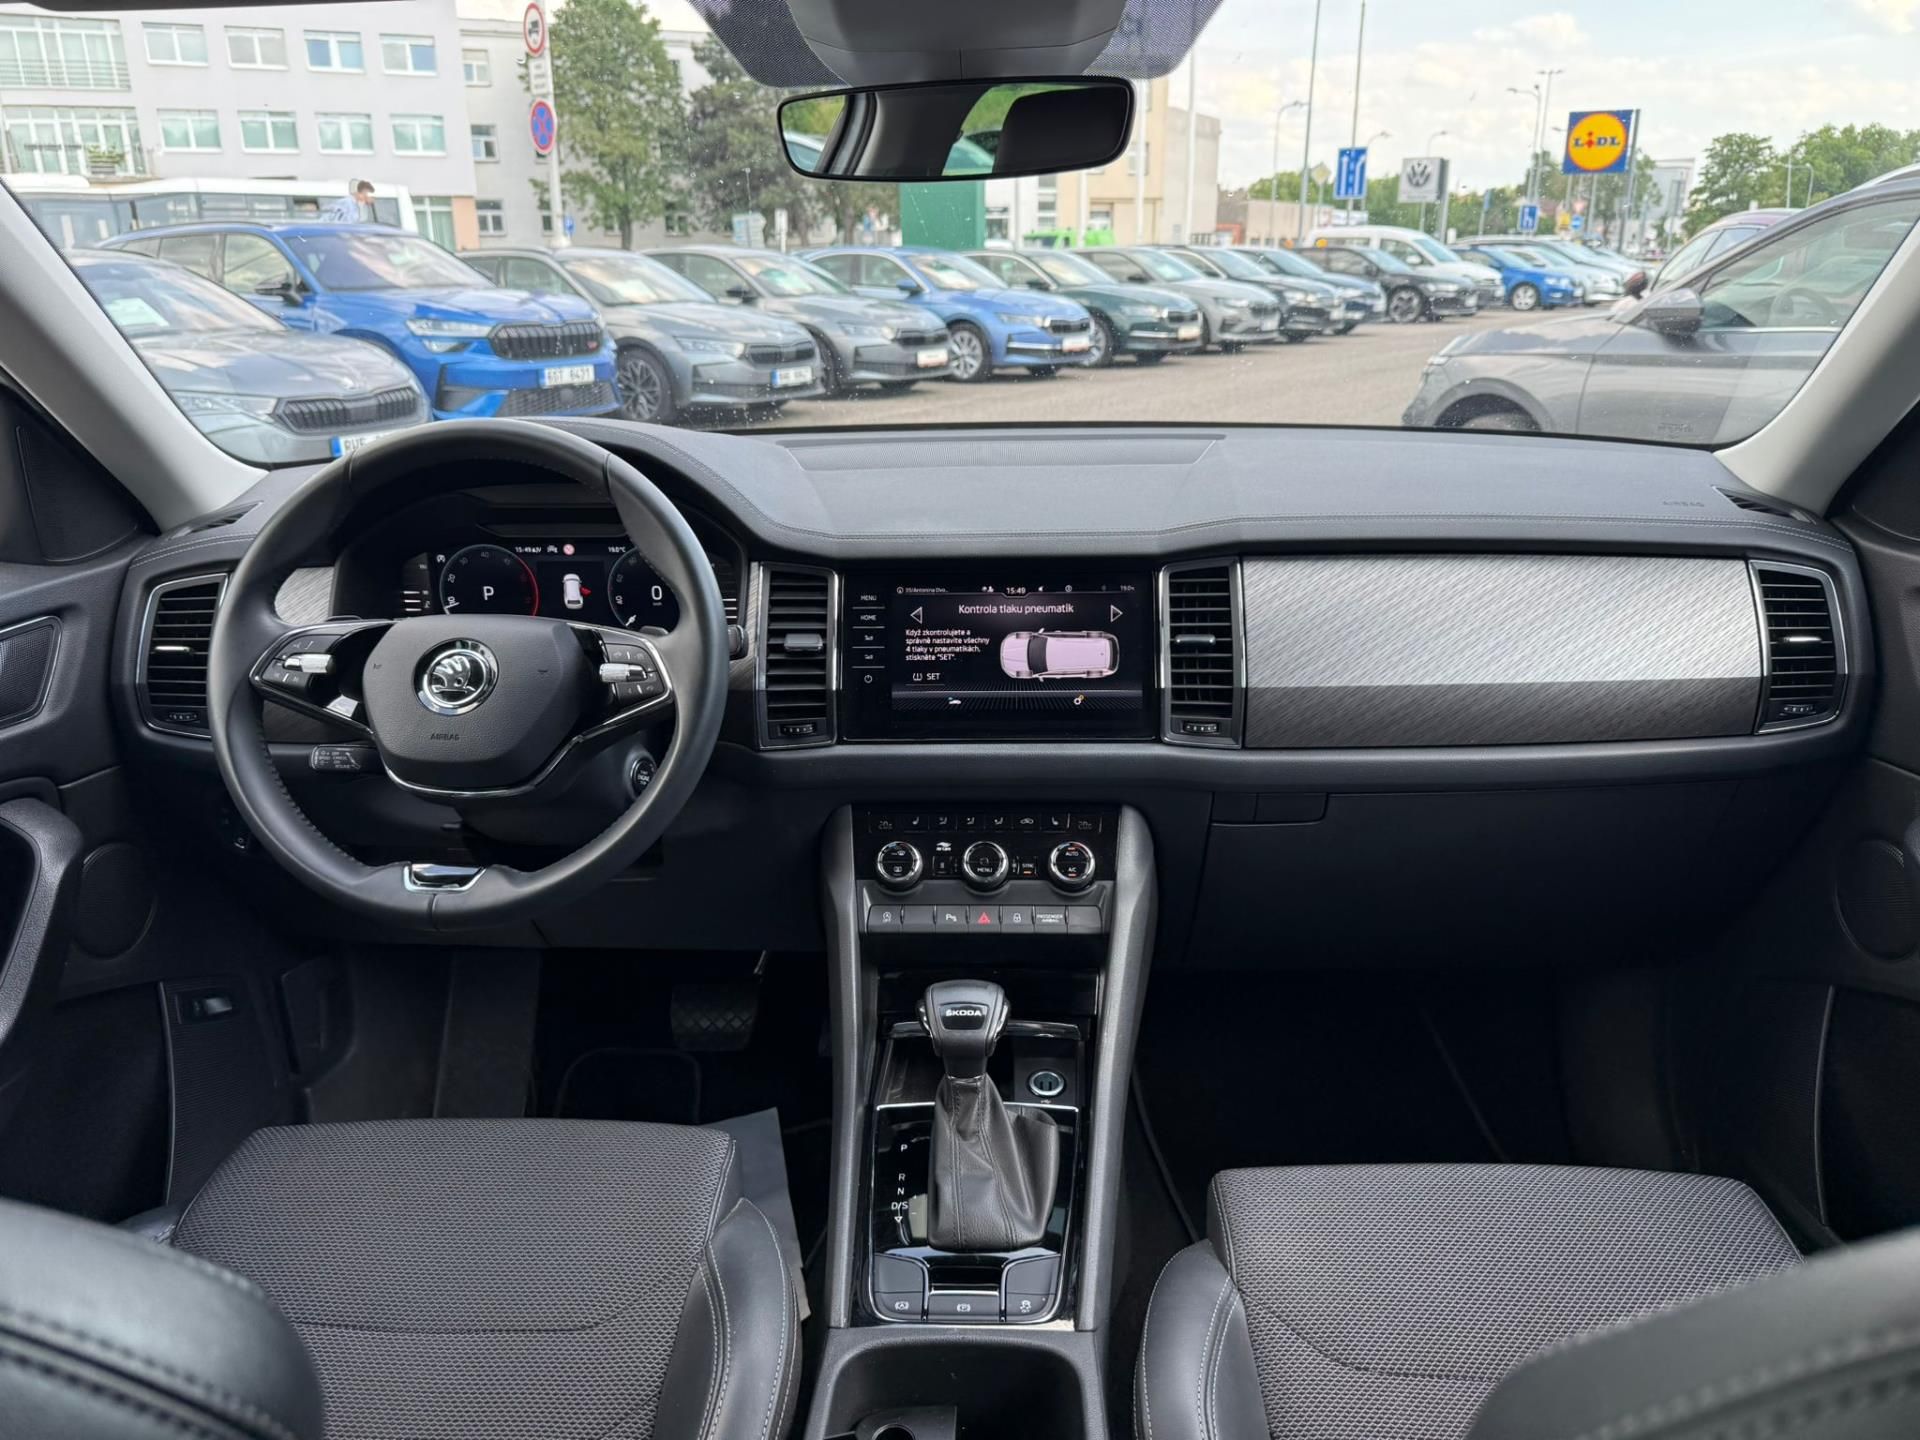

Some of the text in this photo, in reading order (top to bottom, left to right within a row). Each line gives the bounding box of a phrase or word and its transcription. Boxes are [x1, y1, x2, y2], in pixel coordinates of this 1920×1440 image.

[483, 586, 495, 600] P
[651, 585, 663, 600] 0
[1006, 586, 1026, 595] 15:49
[958, 603, 1074, 615] Kontrola tlaku pneumatik
[926, 672, 941, 681] SET
[900, 1143, 908, 1151] P
[898, 1173, 906, 1181] R
[897, 1187, 905, 1195] N
[891, 1201, 909, 1210] D/S
